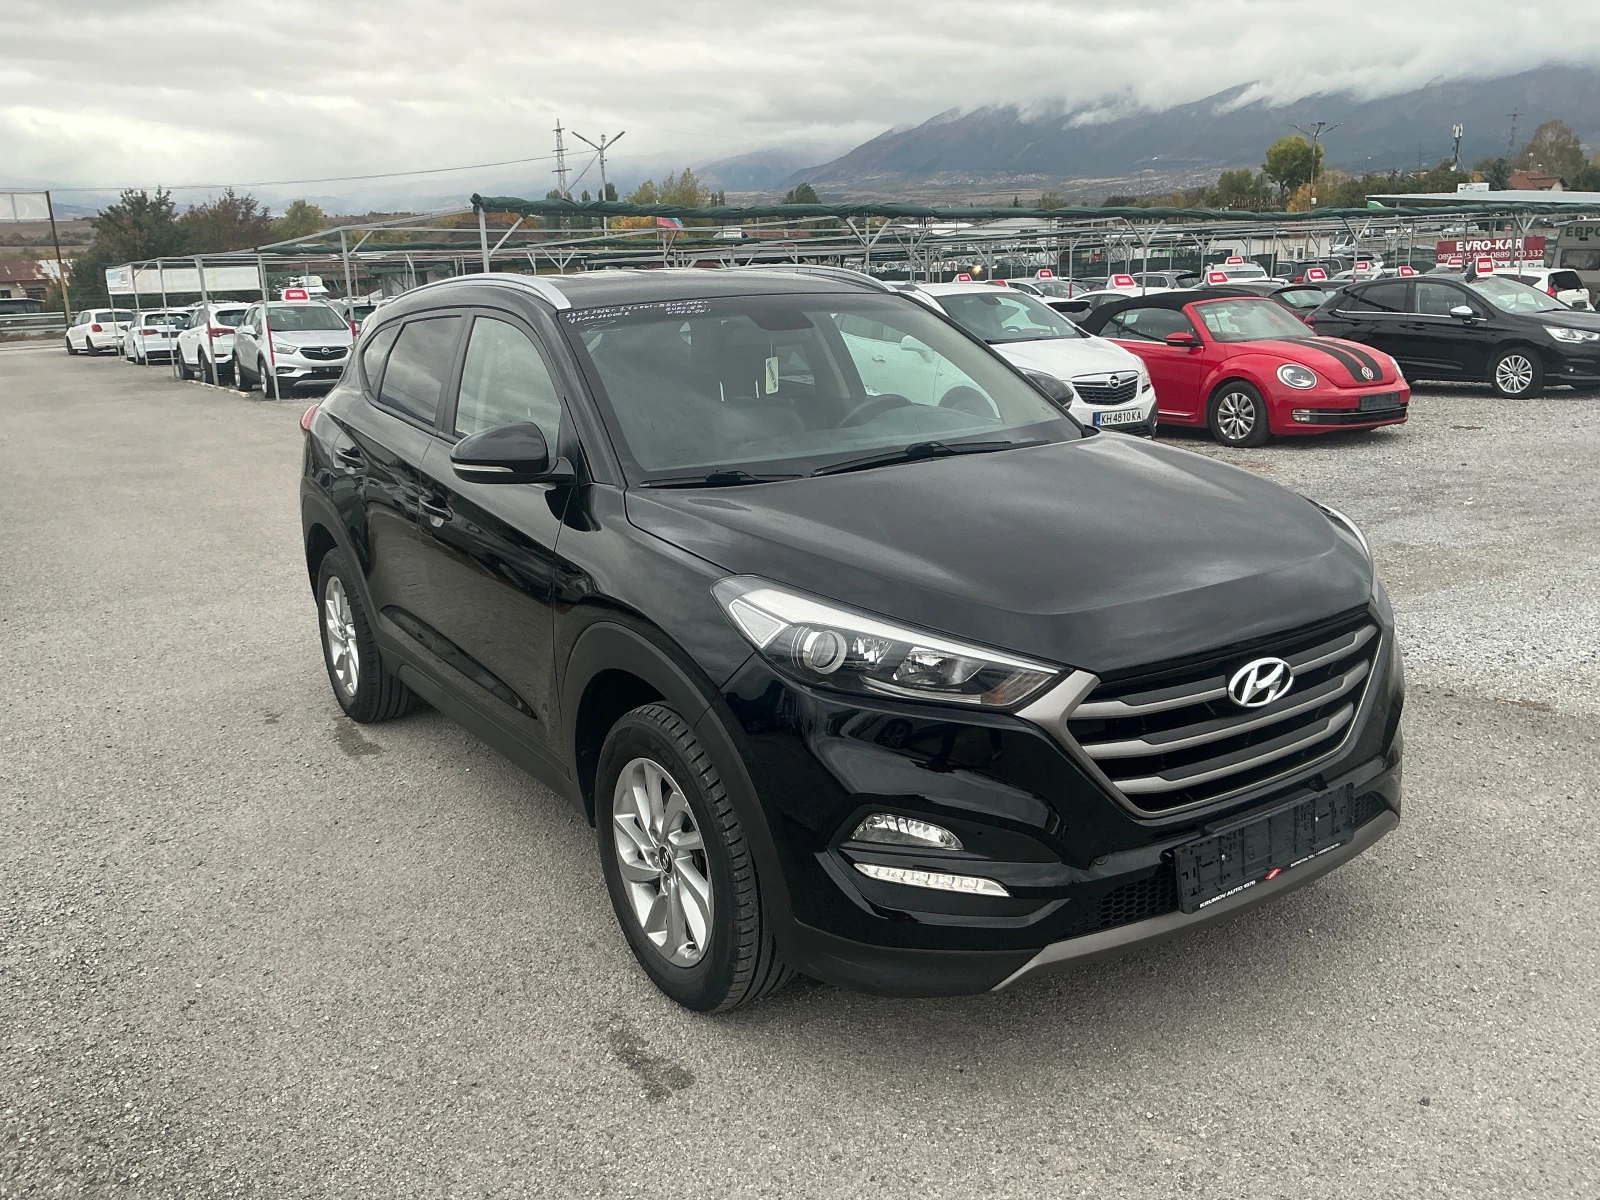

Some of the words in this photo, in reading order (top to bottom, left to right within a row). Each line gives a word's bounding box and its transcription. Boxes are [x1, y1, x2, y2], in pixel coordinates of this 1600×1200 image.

[1456, 238, 1522, 251] EVRO-KAR
[1529, 249, 1544, 257] 332
[1199, 892, 1226, 908] KRUMOV
[1226, 885, 1243, 897] AUTO
